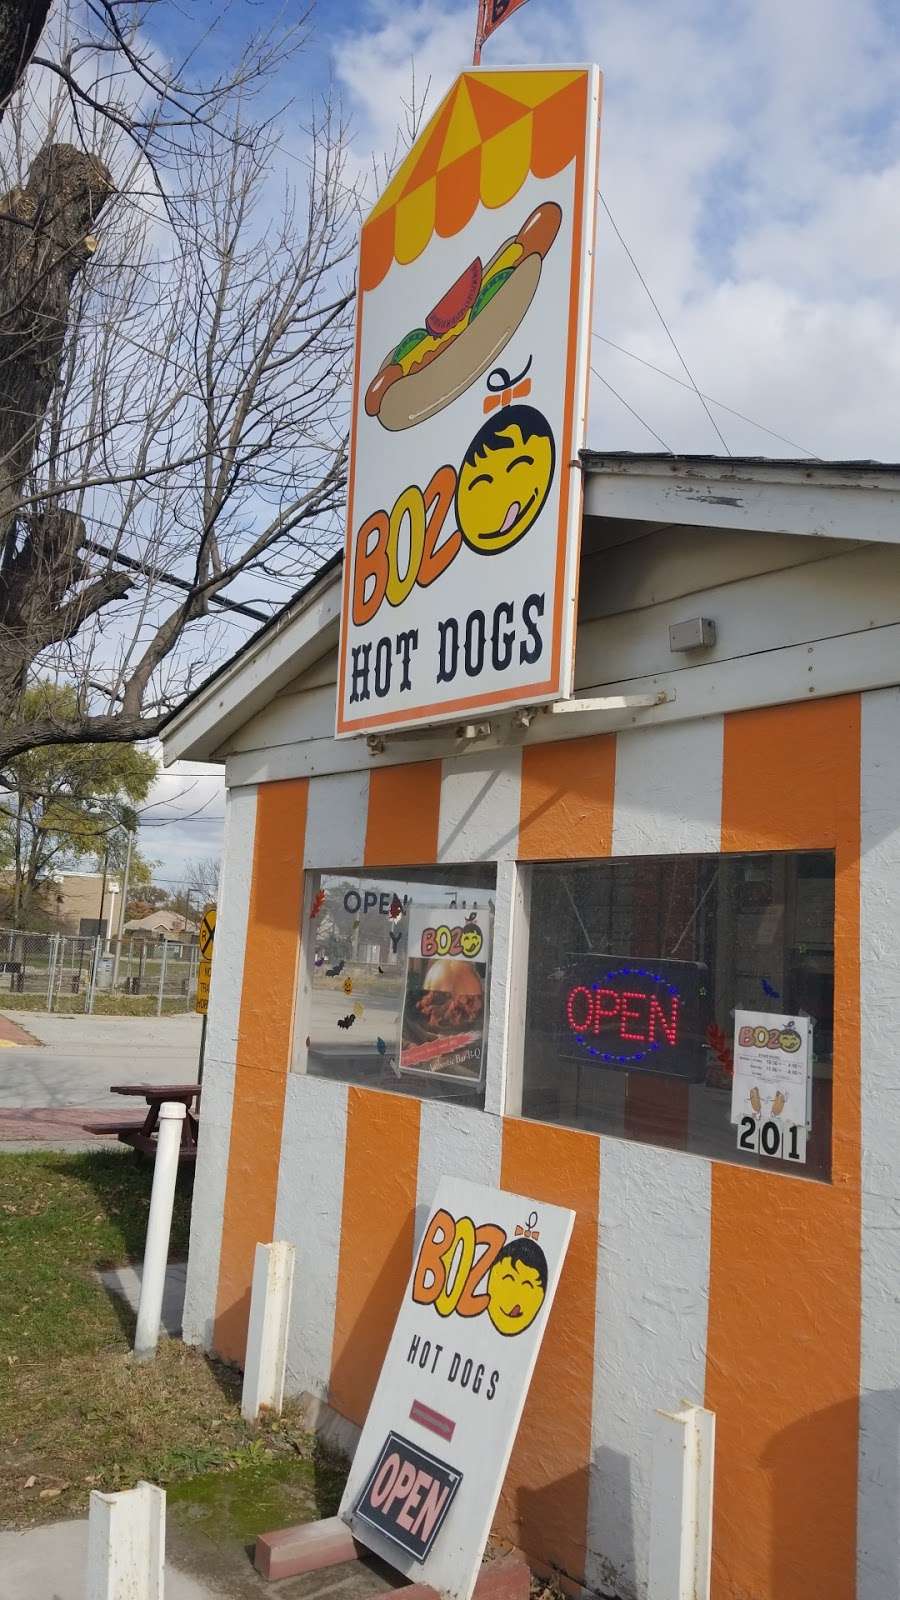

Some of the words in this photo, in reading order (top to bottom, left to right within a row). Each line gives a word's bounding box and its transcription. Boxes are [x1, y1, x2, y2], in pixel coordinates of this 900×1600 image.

[350, 628, 418, 704] HOT
[436, 592, 545, 684] DOGS
[567, 985, 678, 1046] OPEN
[740, 1116, 800, 1160] 201
[407, 1334, 443, 1374] HOT
[448, 1352, 500, 1401] DOGS
[370, 1452, 450, 1543] OPEN
